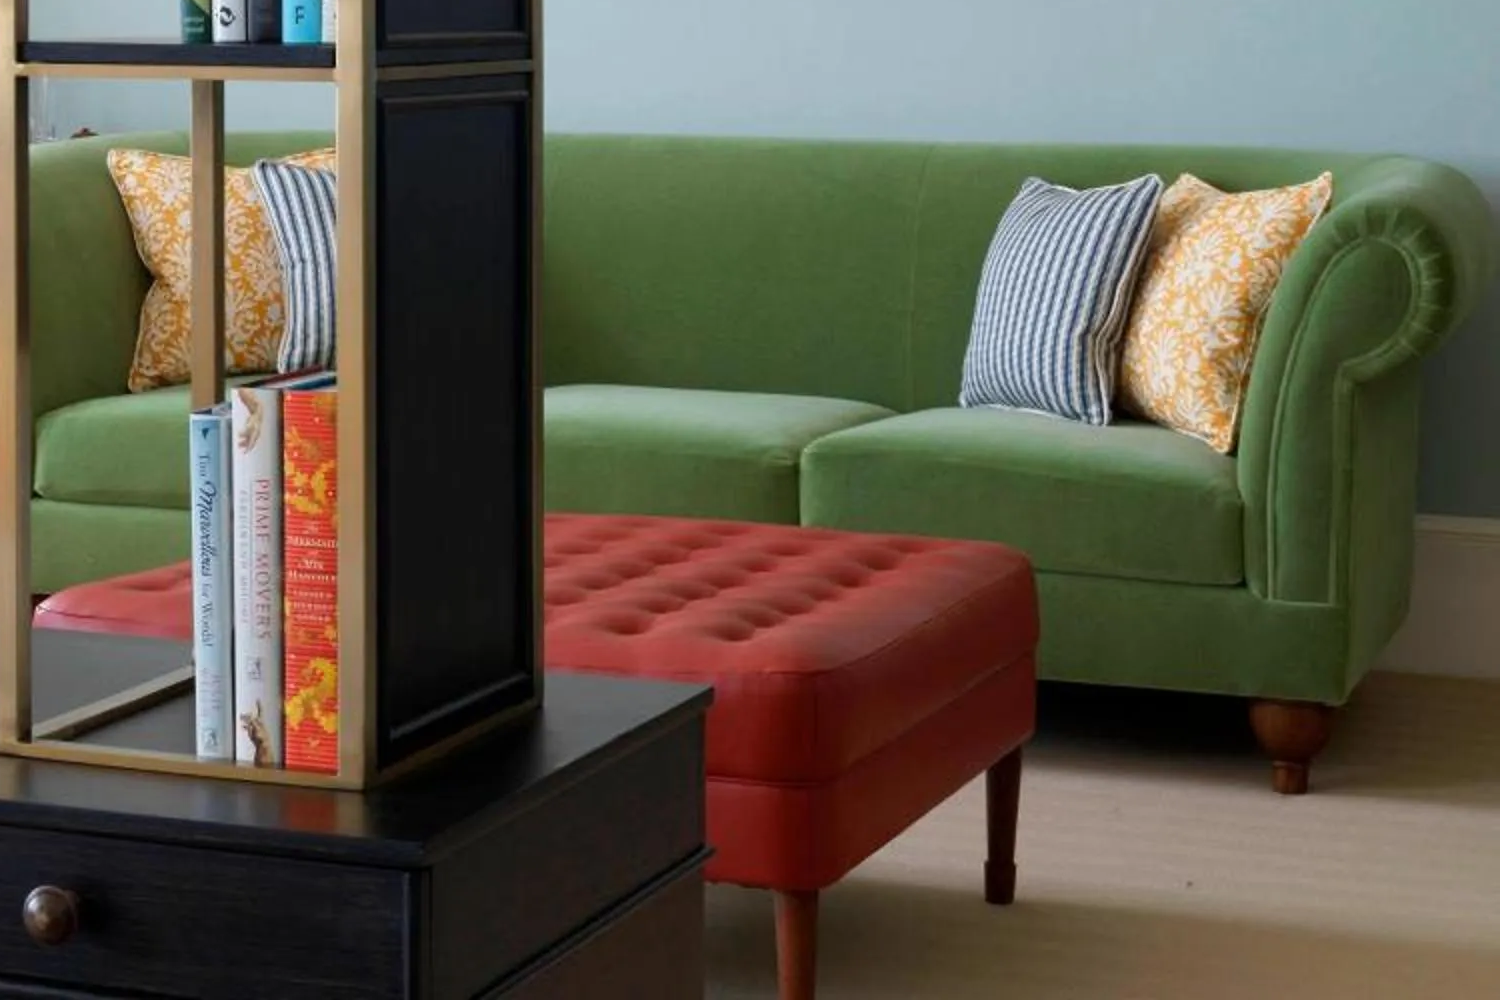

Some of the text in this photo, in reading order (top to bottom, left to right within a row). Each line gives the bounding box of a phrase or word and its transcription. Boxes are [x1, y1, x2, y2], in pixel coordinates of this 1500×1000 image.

[198, 452, 211, 478] Too
[196, 480, 219, 577] Marvellous
[253, 477, 273, 641] PRIME MOVERS
